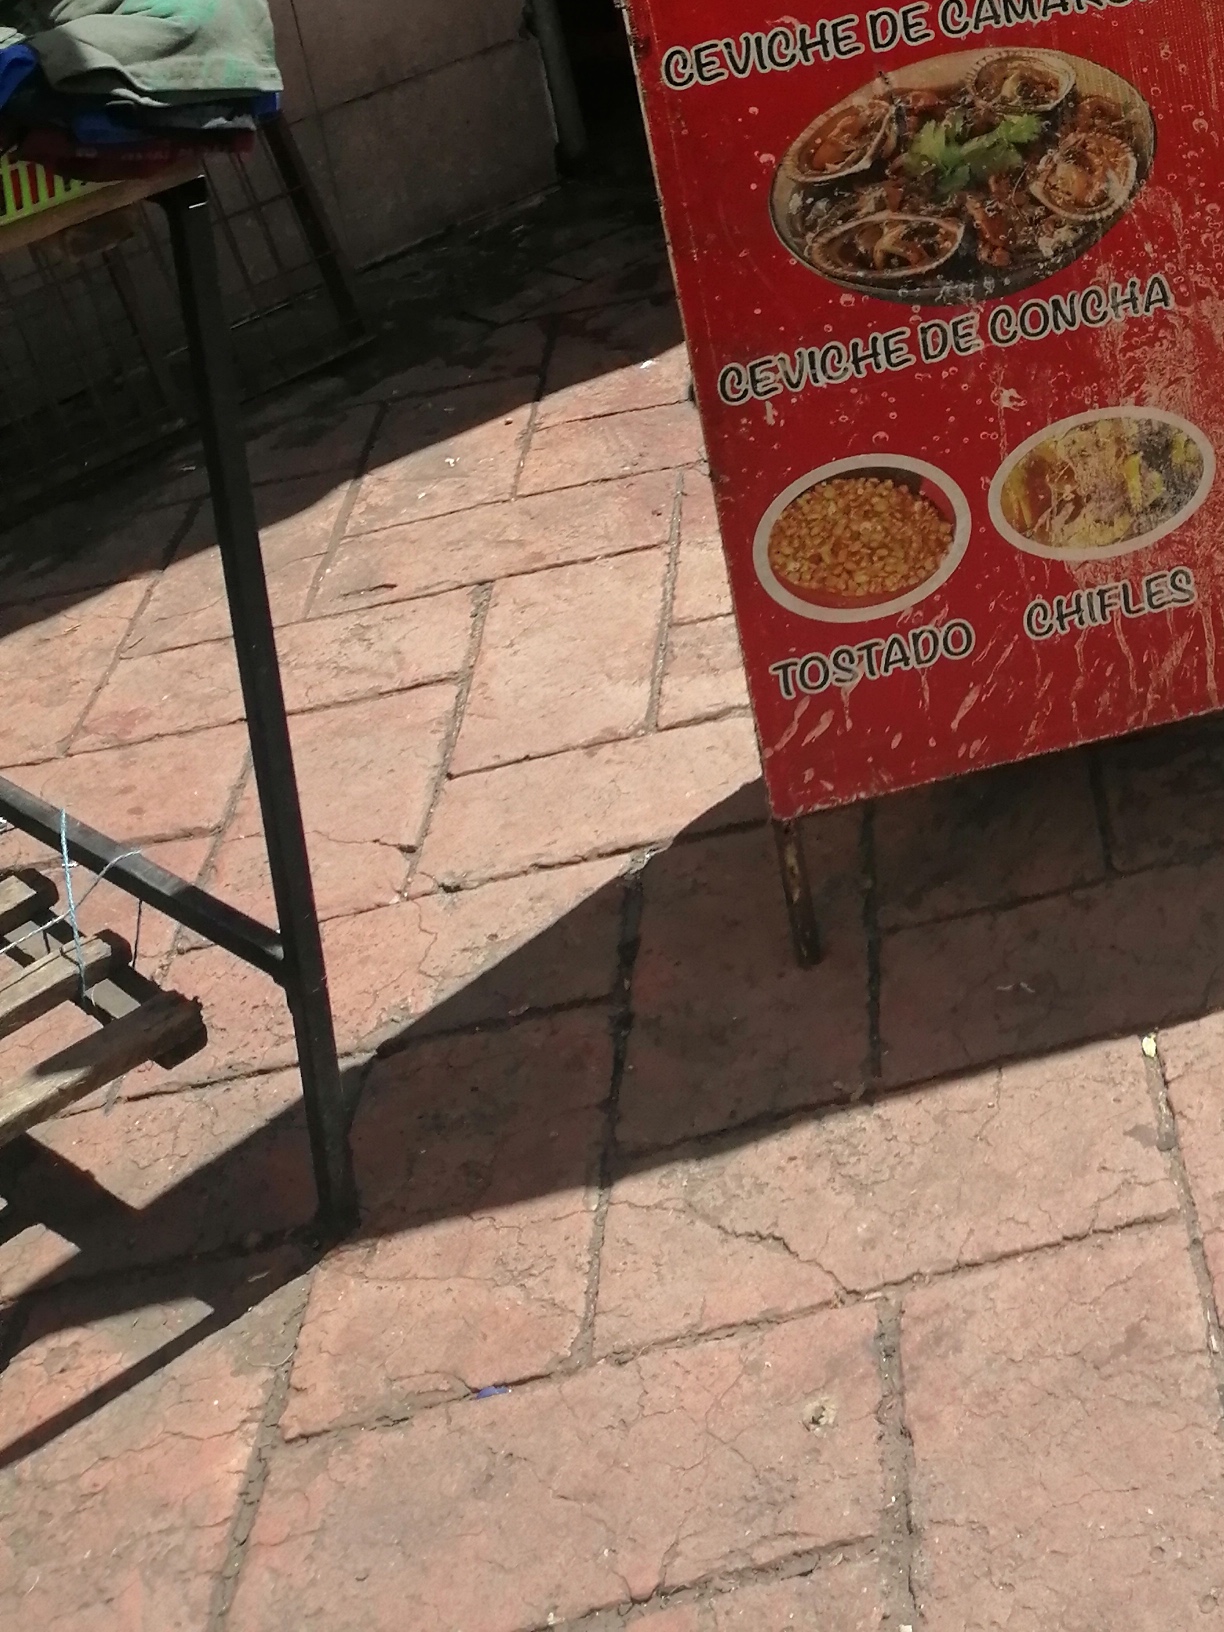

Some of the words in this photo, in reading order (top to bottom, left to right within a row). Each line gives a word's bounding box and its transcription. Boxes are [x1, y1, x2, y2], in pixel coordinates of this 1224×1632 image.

[662, 14, 863, 91] CEVICHE
[867, 2, 934, 54] DE
[717, 328, 915, 405] CEVICHE
[918, 312, 981, 362] DE
[988, 275, 1173, 349] CONCHA
[1023, 568, 1198, 640] CHIFLES
[770, 619, 975, 701] TOSTADO
